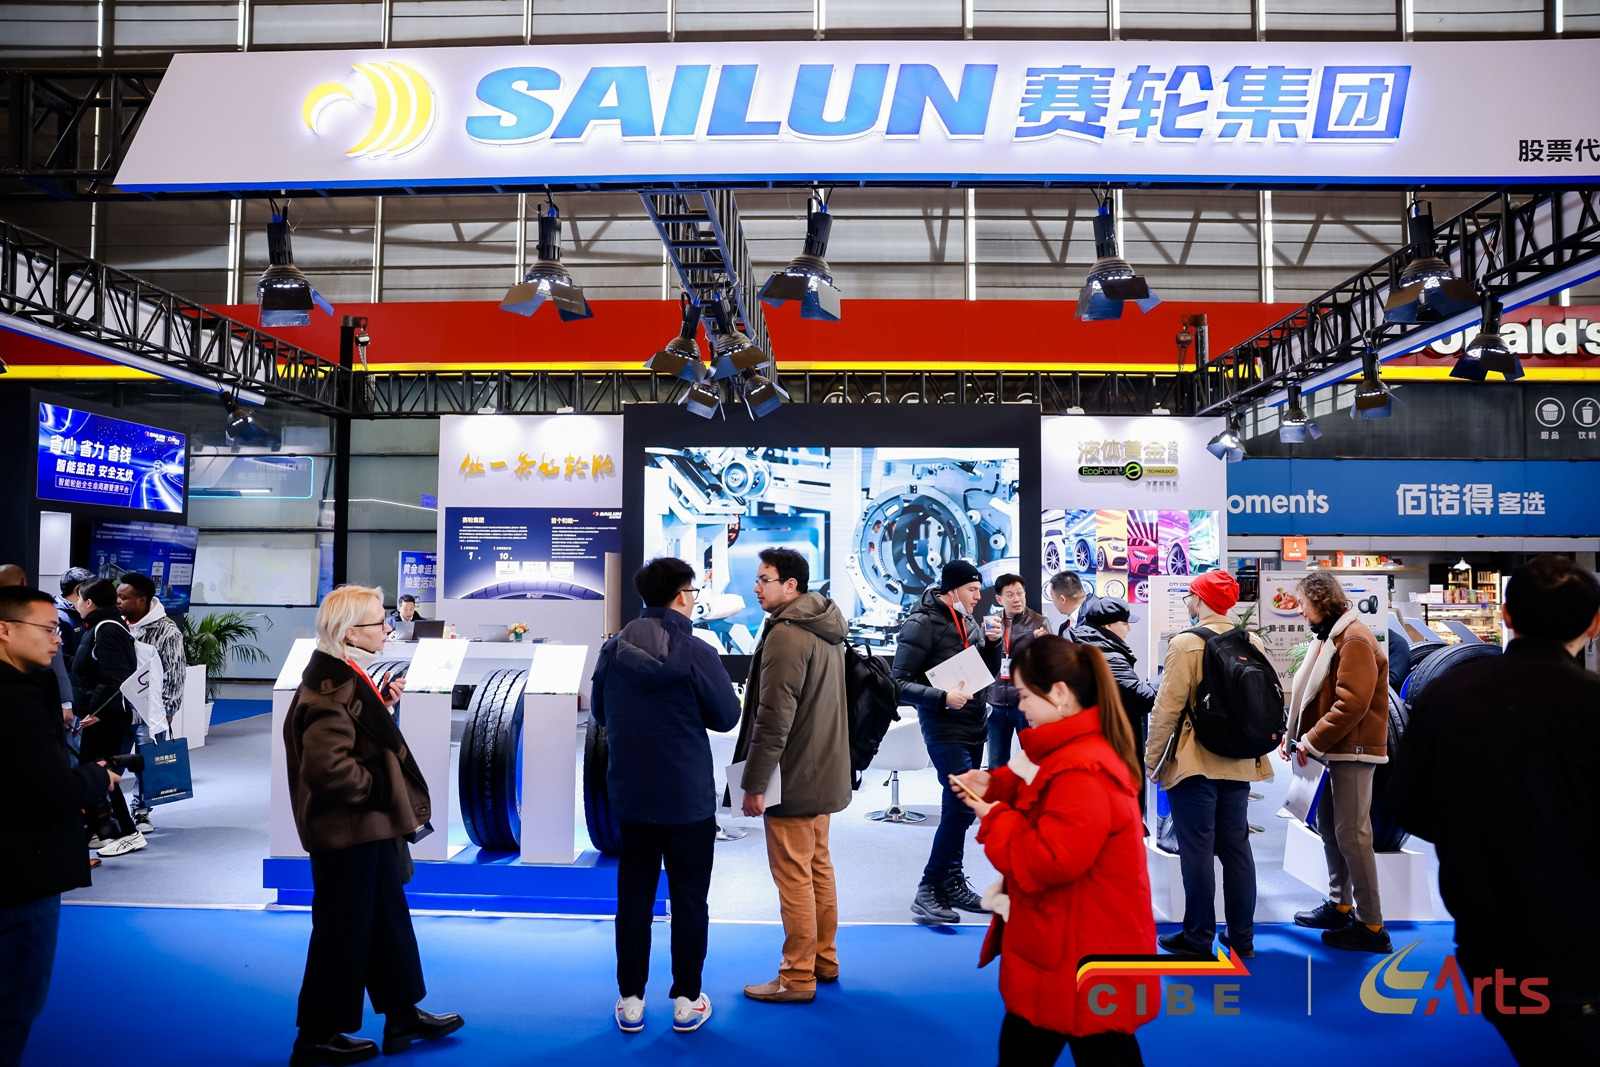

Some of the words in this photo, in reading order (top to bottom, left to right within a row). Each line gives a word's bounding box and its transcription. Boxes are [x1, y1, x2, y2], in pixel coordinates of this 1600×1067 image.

[465, 64, 998, 142] SAILUN
[1012, 64, 1412, 142] 赛轮集团
[1518, 138, 1600, 162] 股票代
[1540, 431, 1560, 440] 甜品
[1578, 431, 1597, 440] 饮料
[50, 434, 77, 456] 省心
[80, 439, 105, 460] 省力
[108, 444, 132, 464] 省钱
[1077, 439, 1167, 462] 液体黄金
[56, 458, 96, 477] 智能监控
[98, 464, 134, 482] 安全无忧
